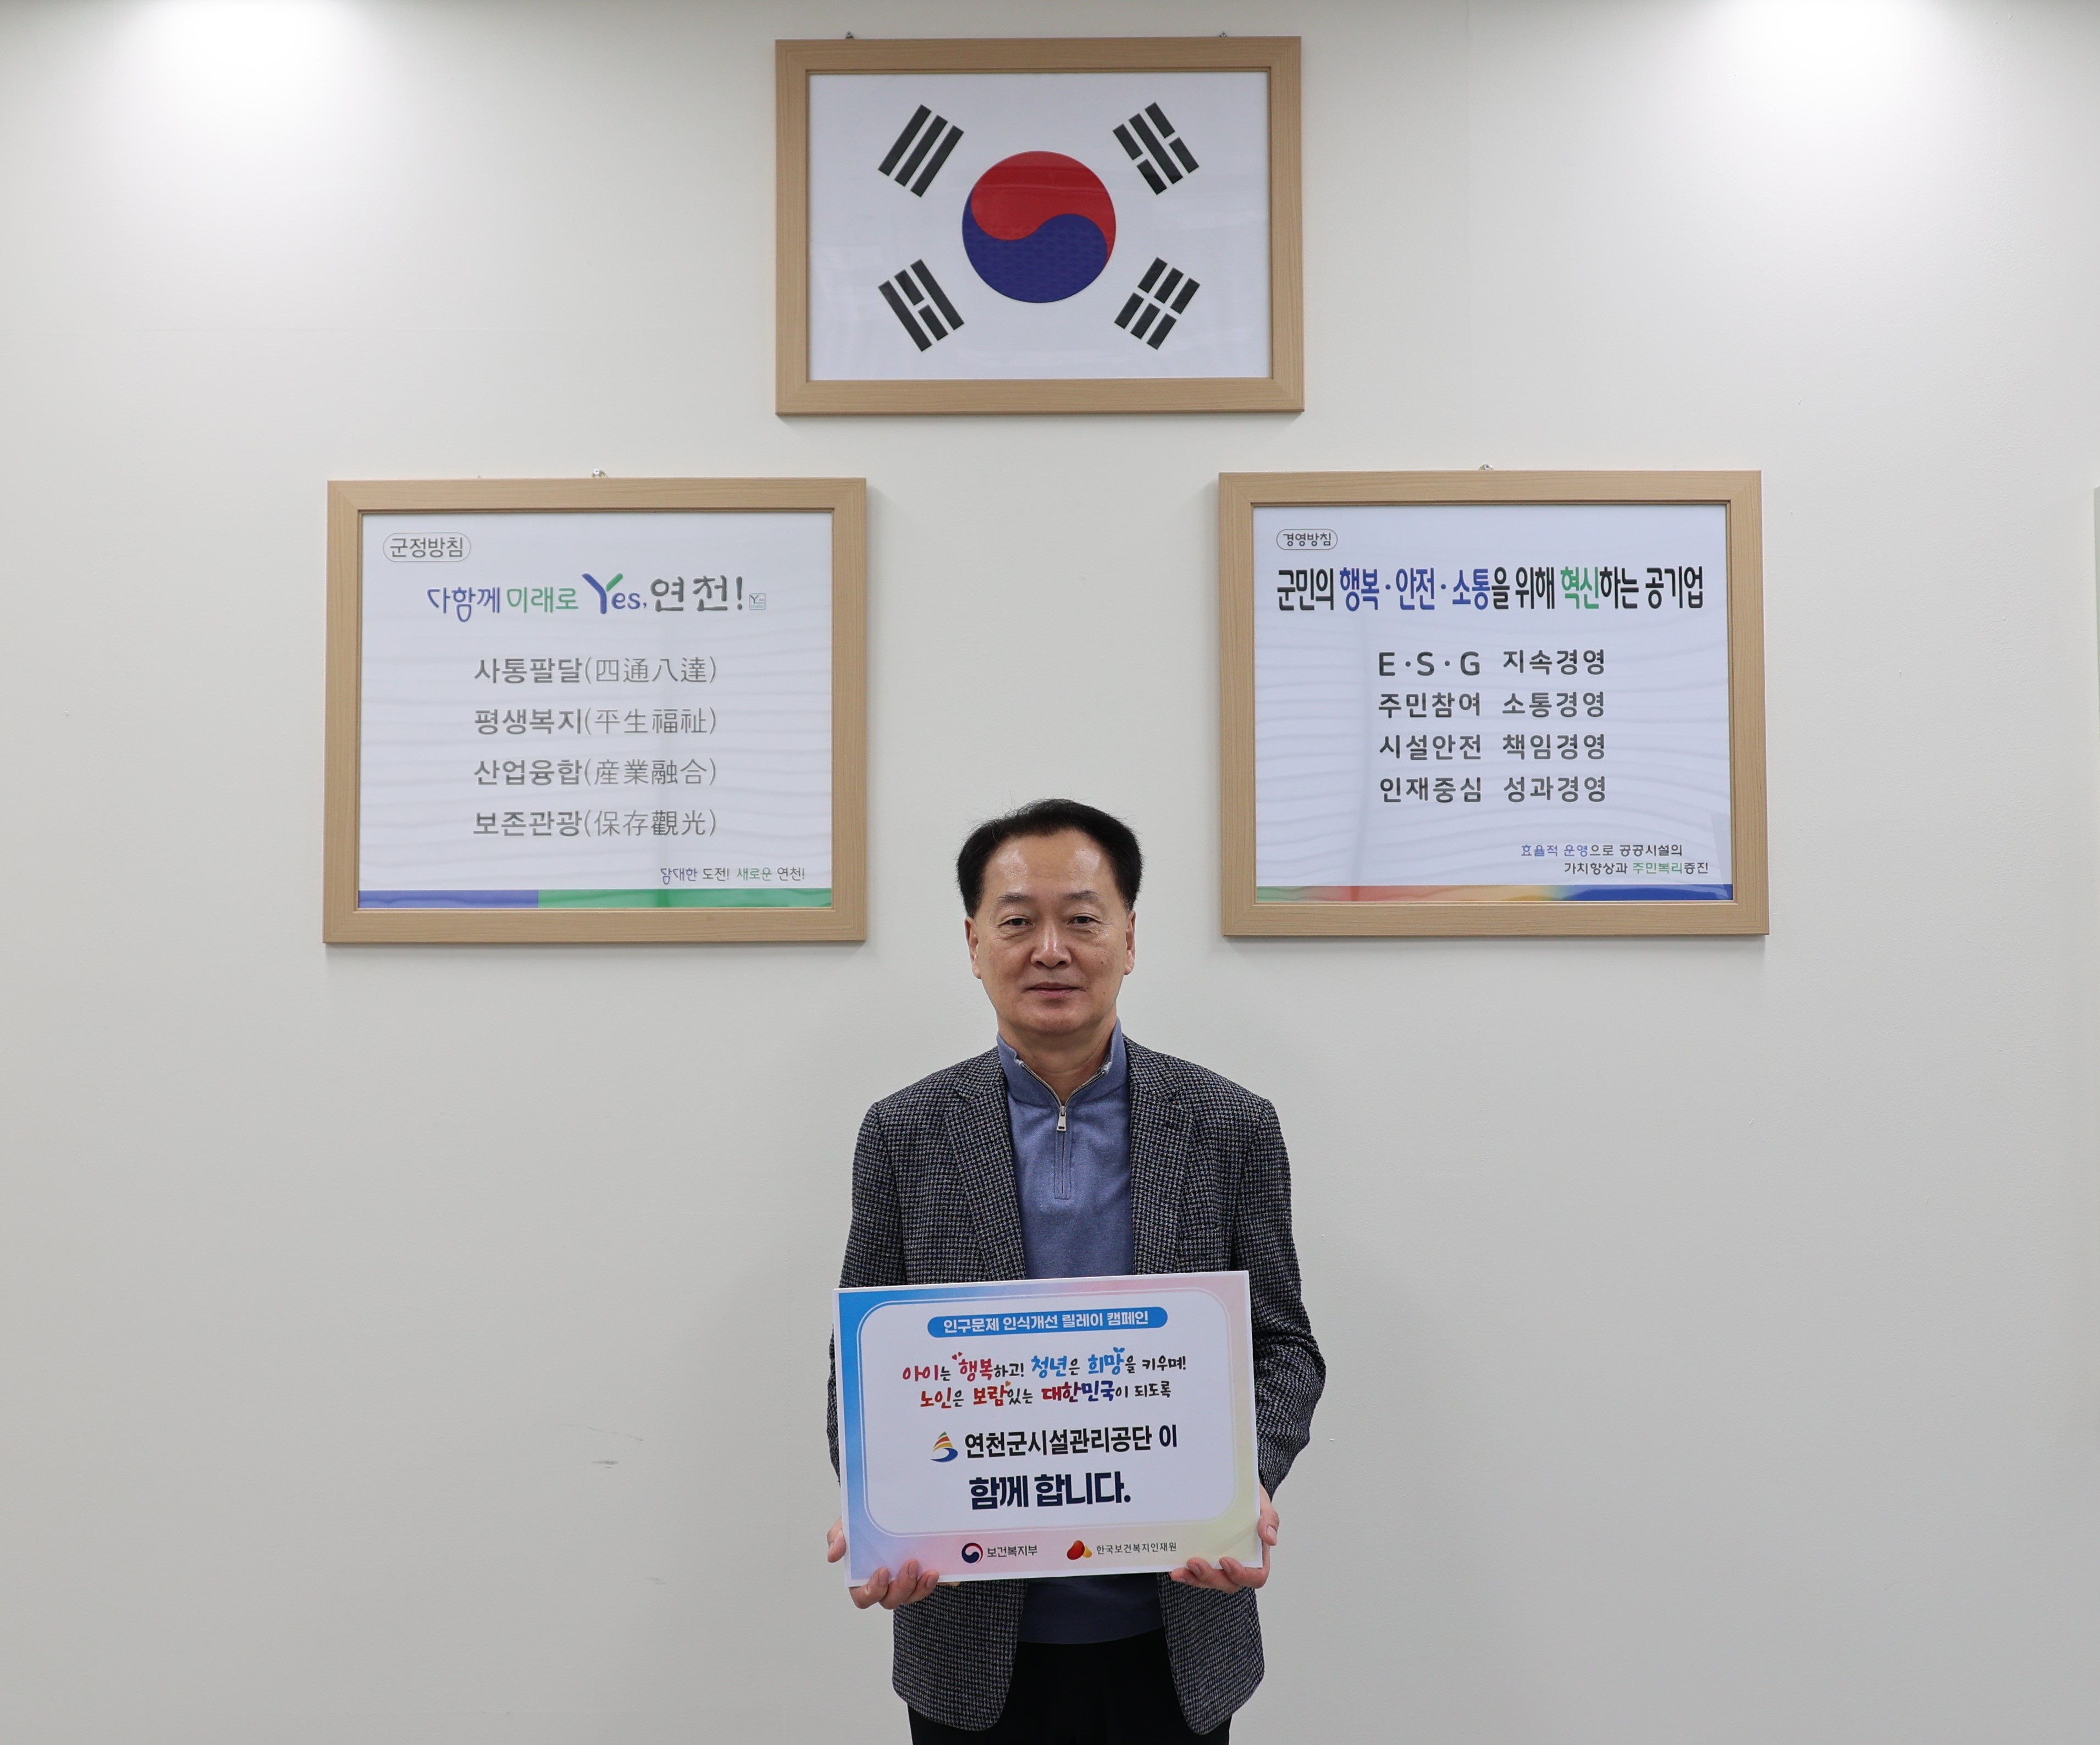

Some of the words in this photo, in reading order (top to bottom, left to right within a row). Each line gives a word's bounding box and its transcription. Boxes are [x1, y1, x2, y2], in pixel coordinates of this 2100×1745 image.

[389, 537, 463, 557] 군정방침
[1283, 531, 1333, 548] 경영방침
[427, 587, 500, 622] 다함께
[507, 587, 578, 613] 미래로
[582, 573, 646, 615] Yes,
[650, 575, 743, 612] 연천!
[1277, 568, 1334, 611] 군민의
[1515, 567, 1555, 609] 위해
[1560, 566, 1639, 609] 혁신하는
[1645, 566, 1703, 609] 공기업
[474, 656, 716, 684] 사통팔달(四通八達)
[1503, 649, 1604, 675] 지속경영
[1378, 692, 1480, 719] 주민참여
[1502, 691, 1604, 717] 소통경영
[474, 707, 716, 735] 평생복지(平生福祉)
[1379, 735, 1481, 760] 시설안전
[1503, 734, 1604, 760] 책임경영
[474, 758, 716, 786] 산업융합(産業融合)
[1380, 777, 1481, 803] 인재중심
[1504, 776, 1605, 803] 성과경영
[473, 809, 716, 837] 보존관광(保存觀光)
[1521, 844, 1557, 857] 효율적
[1564, 844, 1613, 857] 운영으로
[1620, 844, 1682, 857] 공공시설의
[702, 868, 730, 881] 도전!
[737, 868, 772, 881] 새로운
[777, 867, 804, 881] 연천!
[1565, 863, 1628, 875] 가치향상과
[1633, 863, 1708, 875] 주민복리증진
[943, 1317, 999, 1333] 인구문제
[1002, 1316, 1058, 1331] 인식개선
[1062, 1313, 1103, 1328] 릴레이
[1107, 1311, 1148, 1326] 캠페인
[903, 1365, 950, 1382] 아이는
[958, 1359, 1024, 1382] 행복하고!
[1031, 1355, 1080, 1378] 청년은
[1088, 1351, 1136, 1375] 희망을
[1142, 1355, 1186, 1371] 키우며!
[920, 1387, 964, 1409] 노인은
[973, 1384, 1033, 1406] 보람있는
[1041, 1380, 1128, 1402] 대한민국이
[1135, 1380, 1171, 1398] 되도록
[965, 1426, 1152, 1458] 연천군시설관리공단
[1159, 1424, 1177, 1447] 이
[969, 1475, 1029, 1510] 함께
[1034, 1471, 1131, 1507] 합니다.
[987, 1545, 1037, 1557] 보건복지부
[1097, 1542, 1176, 1554] 한국보건복지인재원
